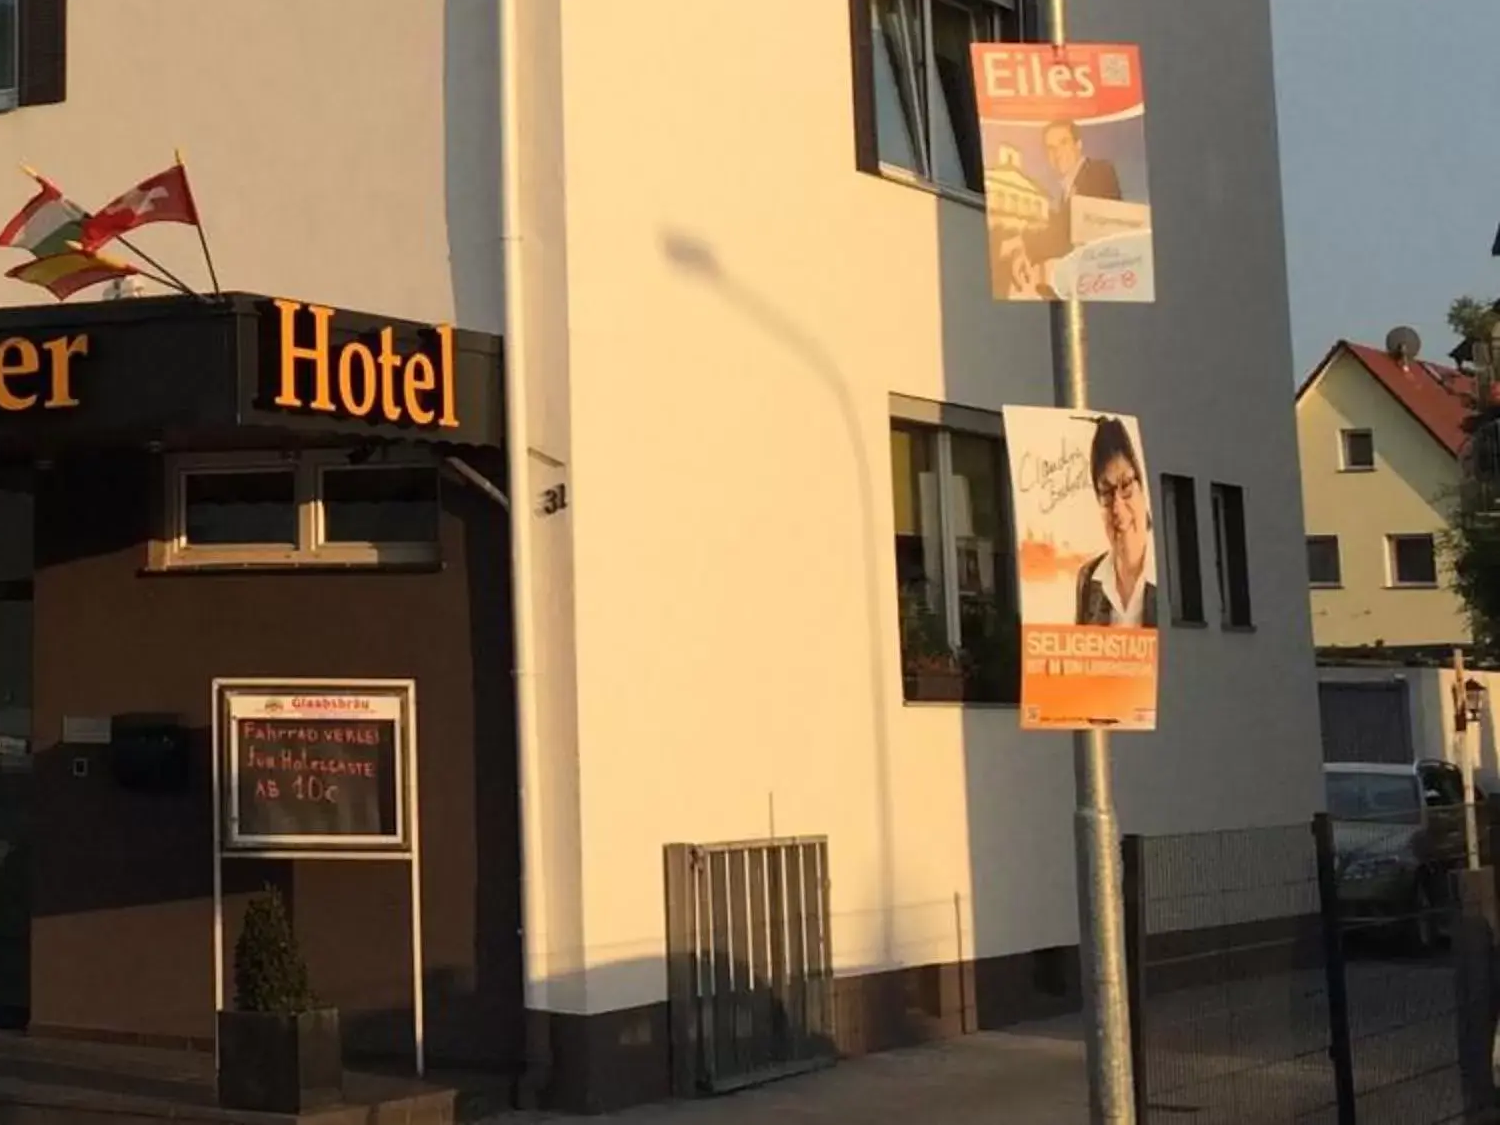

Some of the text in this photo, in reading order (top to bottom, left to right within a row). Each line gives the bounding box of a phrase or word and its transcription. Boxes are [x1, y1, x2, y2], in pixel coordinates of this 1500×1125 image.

[983, 51, 1095, 98] Eiles
[273, 298, 460, 427] Hotel
[544, 483, 567, 514] 31
[1026, 631, 1156, 659] SELIGENSTADT
